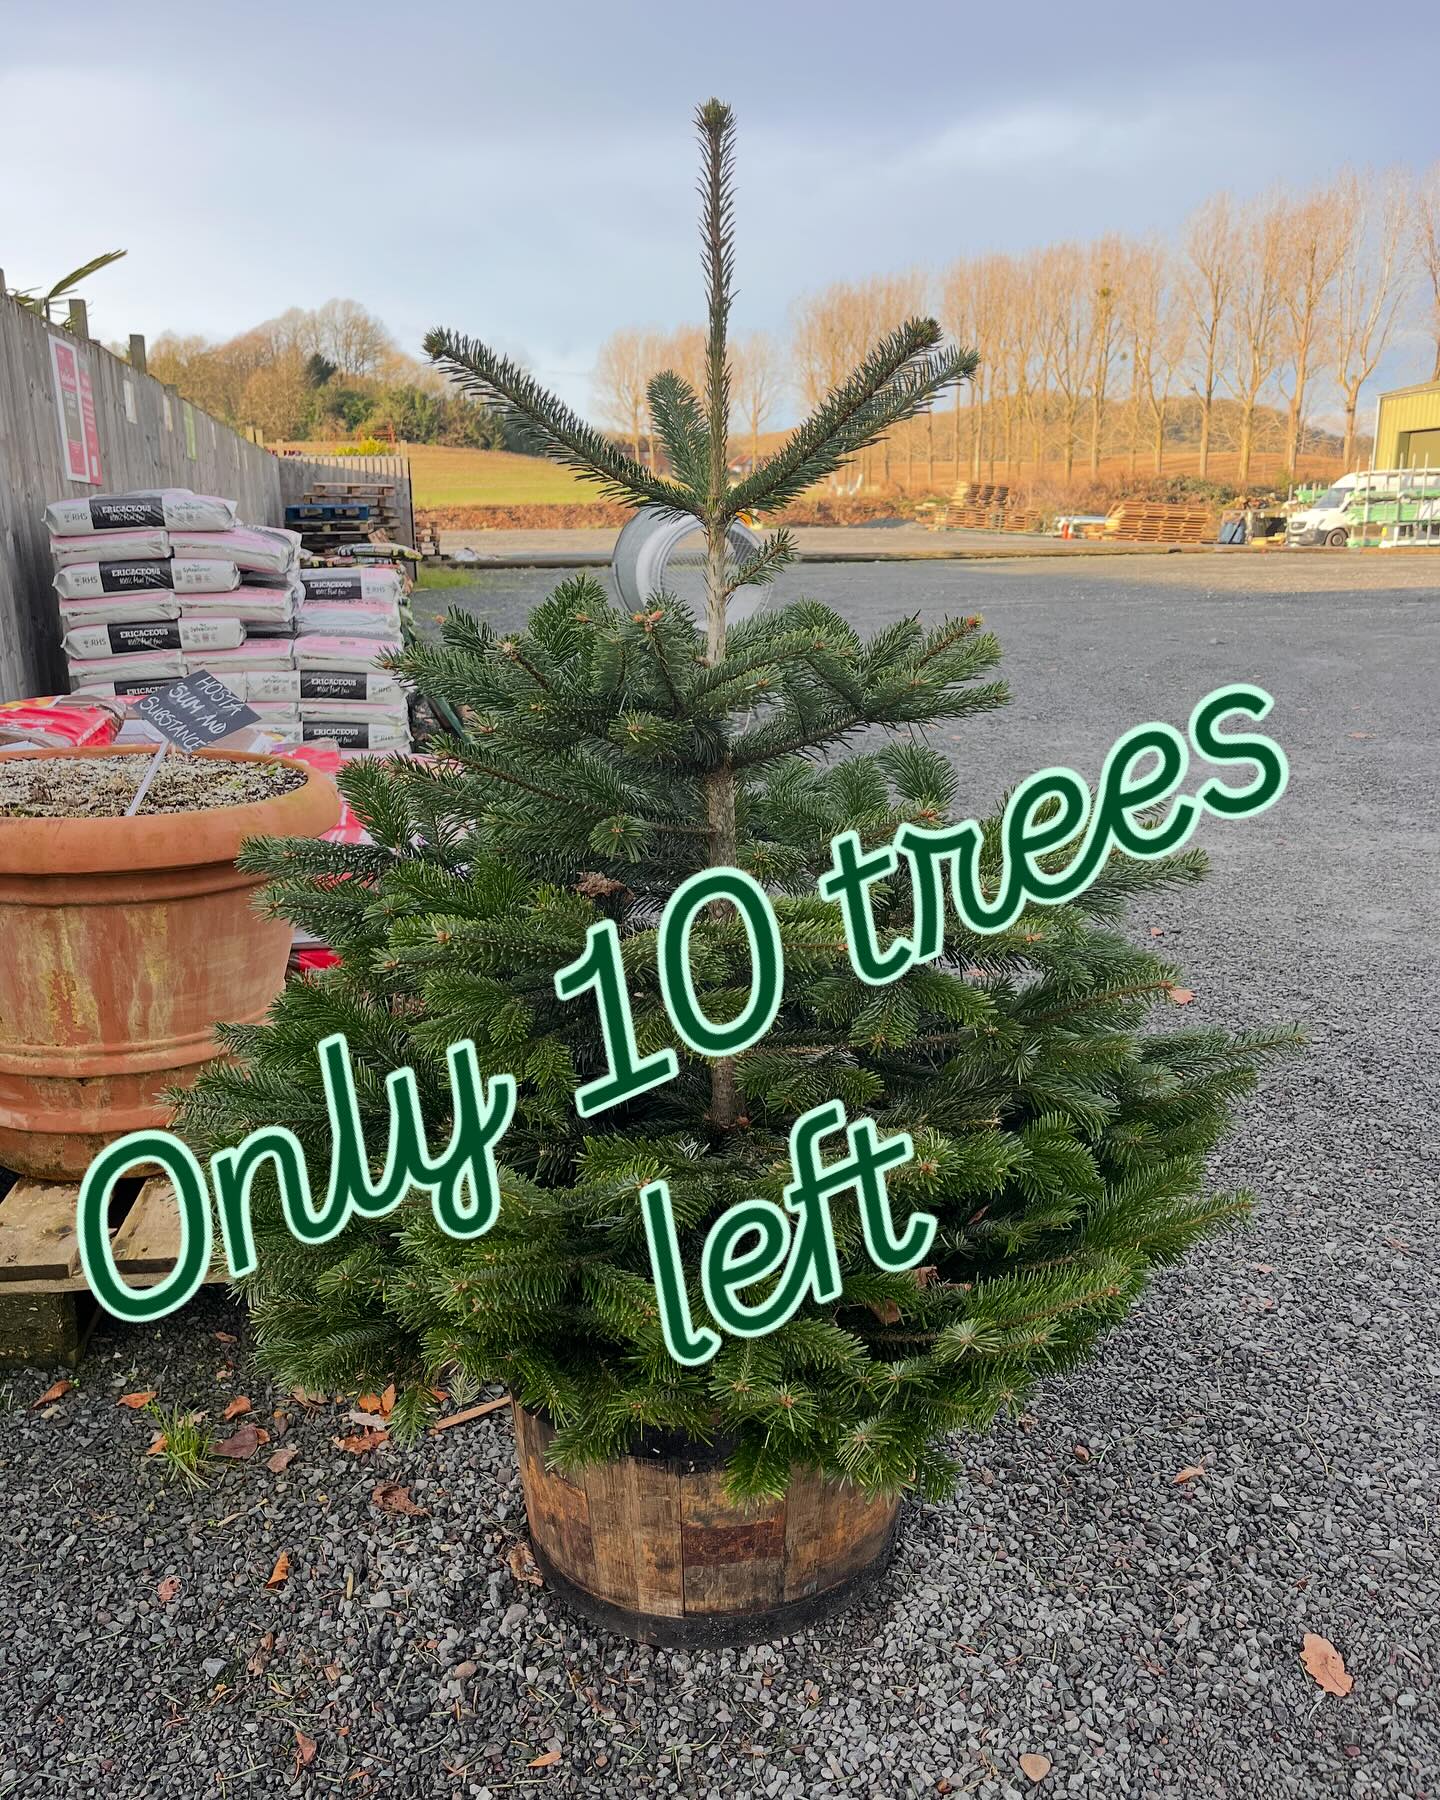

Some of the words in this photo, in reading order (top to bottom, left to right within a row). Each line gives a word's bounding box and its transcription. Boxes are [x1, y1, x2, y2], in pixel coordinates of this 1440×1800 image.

[102, 504, 151, 514] ERICACEOUS
[72, 511, 88, 522] RHS
[112, 567, 161, 577] ERICACEOUS
[82, 575, 98, 585] RHS
[120, 628, 168, 638] ERICACEOUS
[91, 638, 107, 647] RHS
[311, 677, 357, 686] ERICACEOUS
[195, 675, 245, 717] HOSTA
[196, 712, 227, 735] AND
[313, 728, 359, 736] ERICACEOUS
